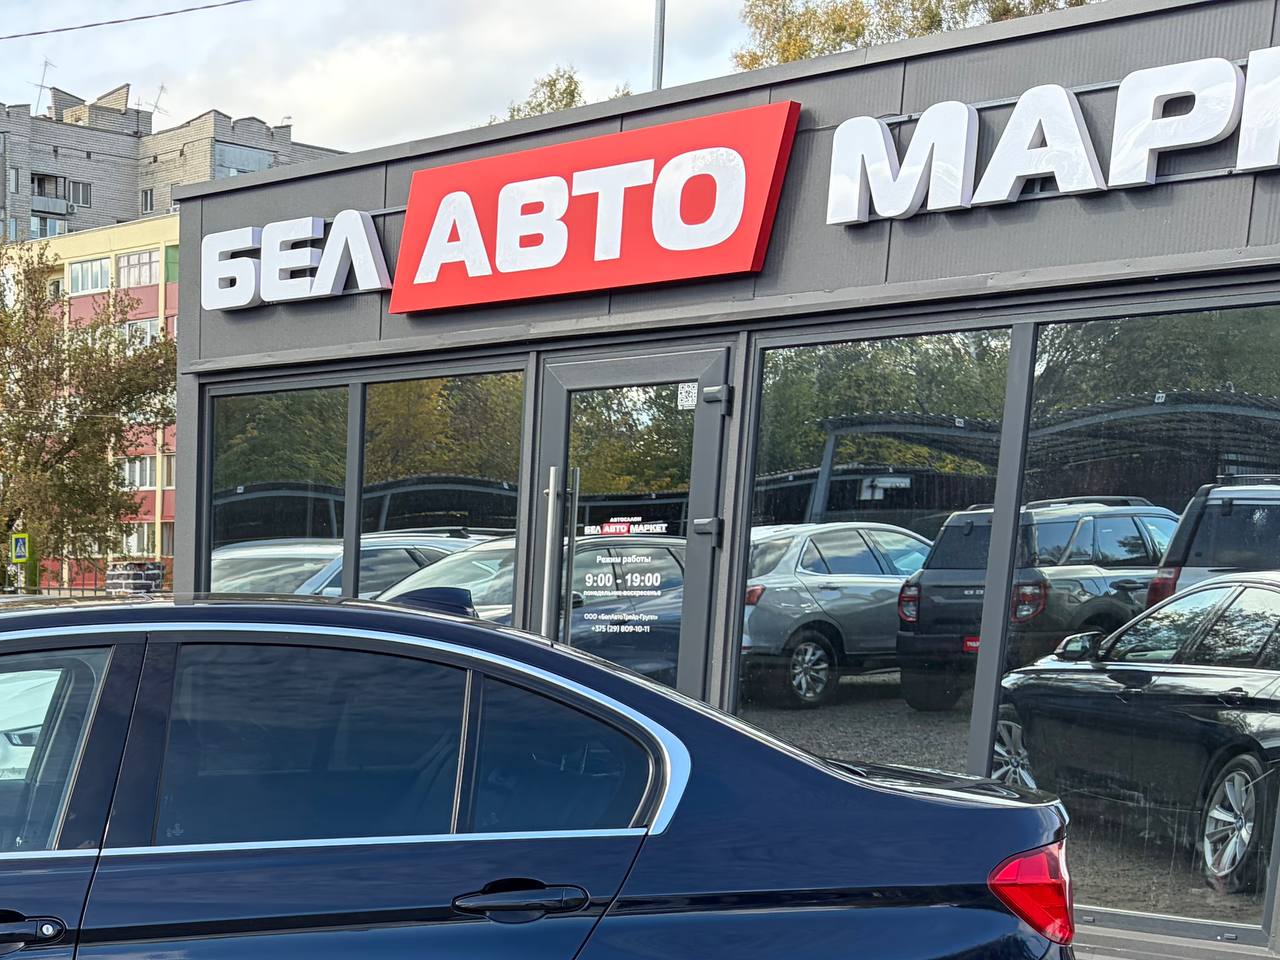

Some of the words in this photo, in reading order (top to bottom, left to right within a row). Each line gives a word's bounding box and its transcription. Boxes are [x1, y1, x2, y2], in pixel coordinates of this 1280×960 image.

[201, 209, 392, 311] БЕЛ
[413, 146, 747, 285] АВТО
[584, 525, 602, 535] БЕЛ
[603, 524, 628, 534] АВТО
[629, 523, 668, 534] МАРКЕТ
[596, 555, 621, 563] Режим
[622, 555, 652, 564] работы
[585, 573, 613, 586] 9:00
[625, 573, 661, 586] 19:00
[607, 625, 619, 633] (29)
